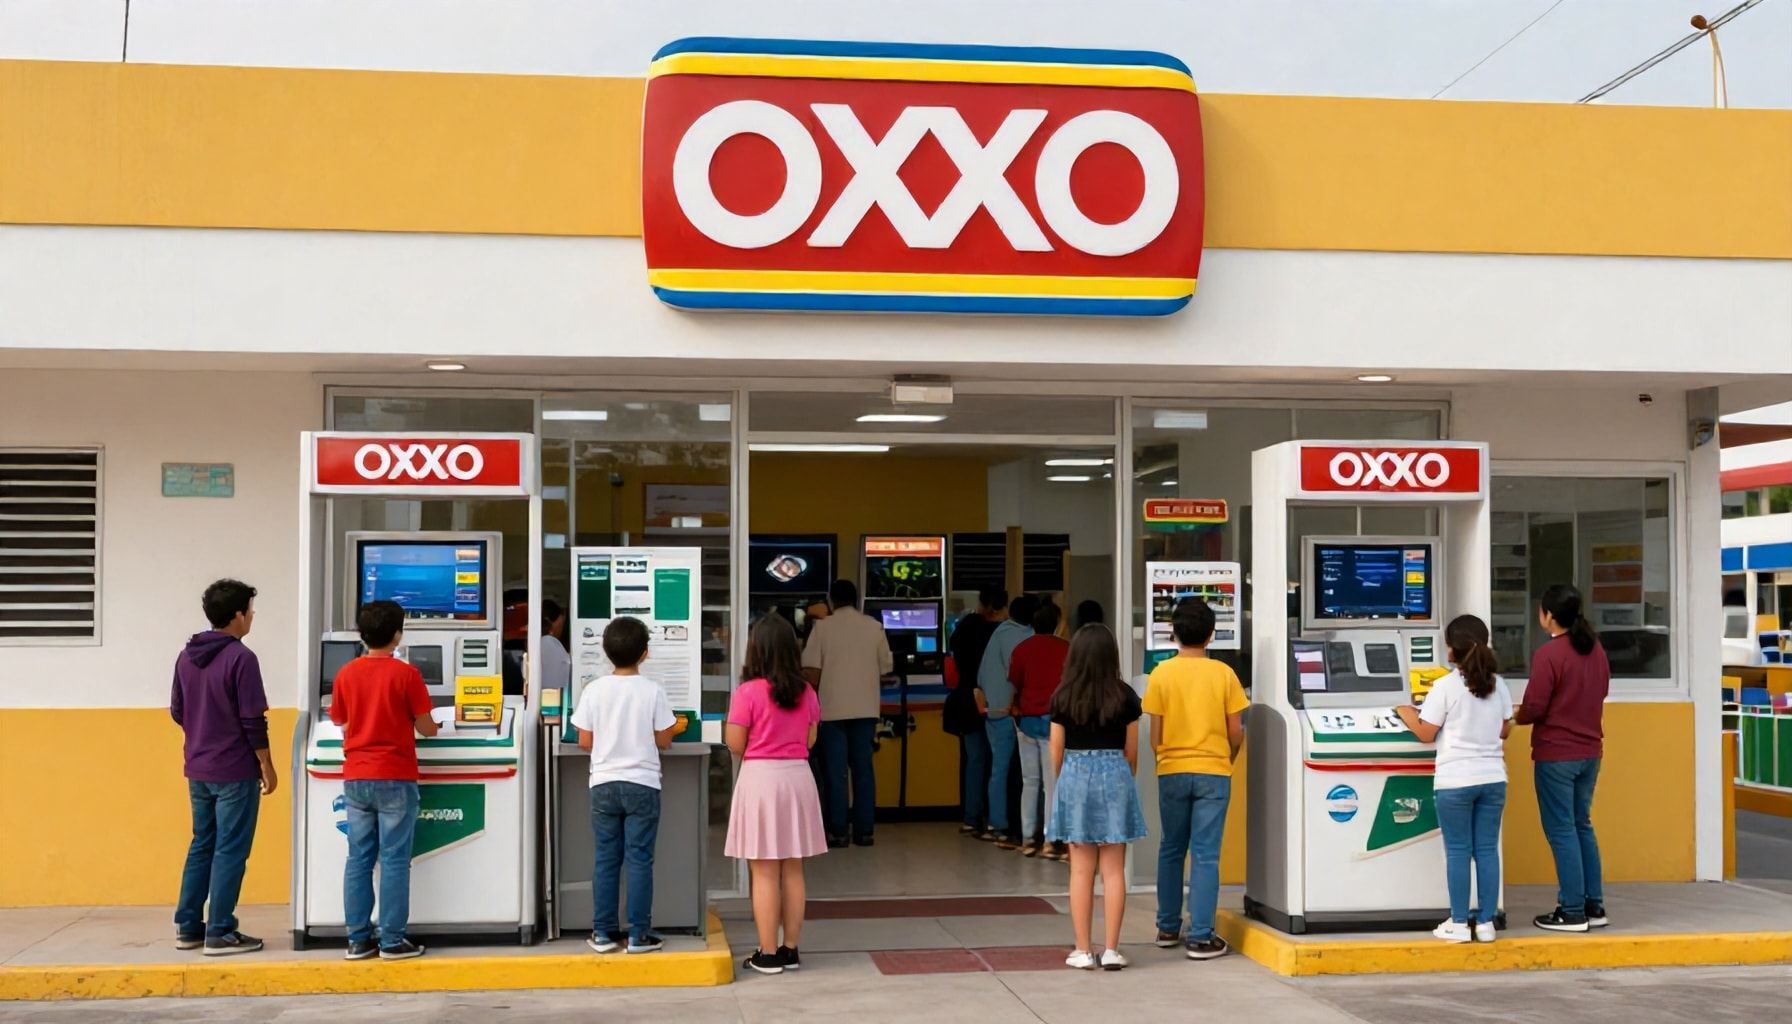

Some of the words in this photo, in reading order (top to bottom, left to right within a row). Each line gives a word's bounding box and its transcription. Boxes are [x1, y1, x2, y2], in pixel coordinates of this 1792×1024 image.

[673, 100, 1179, 256] OXXO
[354, 444, 484, 480] OXXO
[1330, 452, 1449, 488] OXXO
